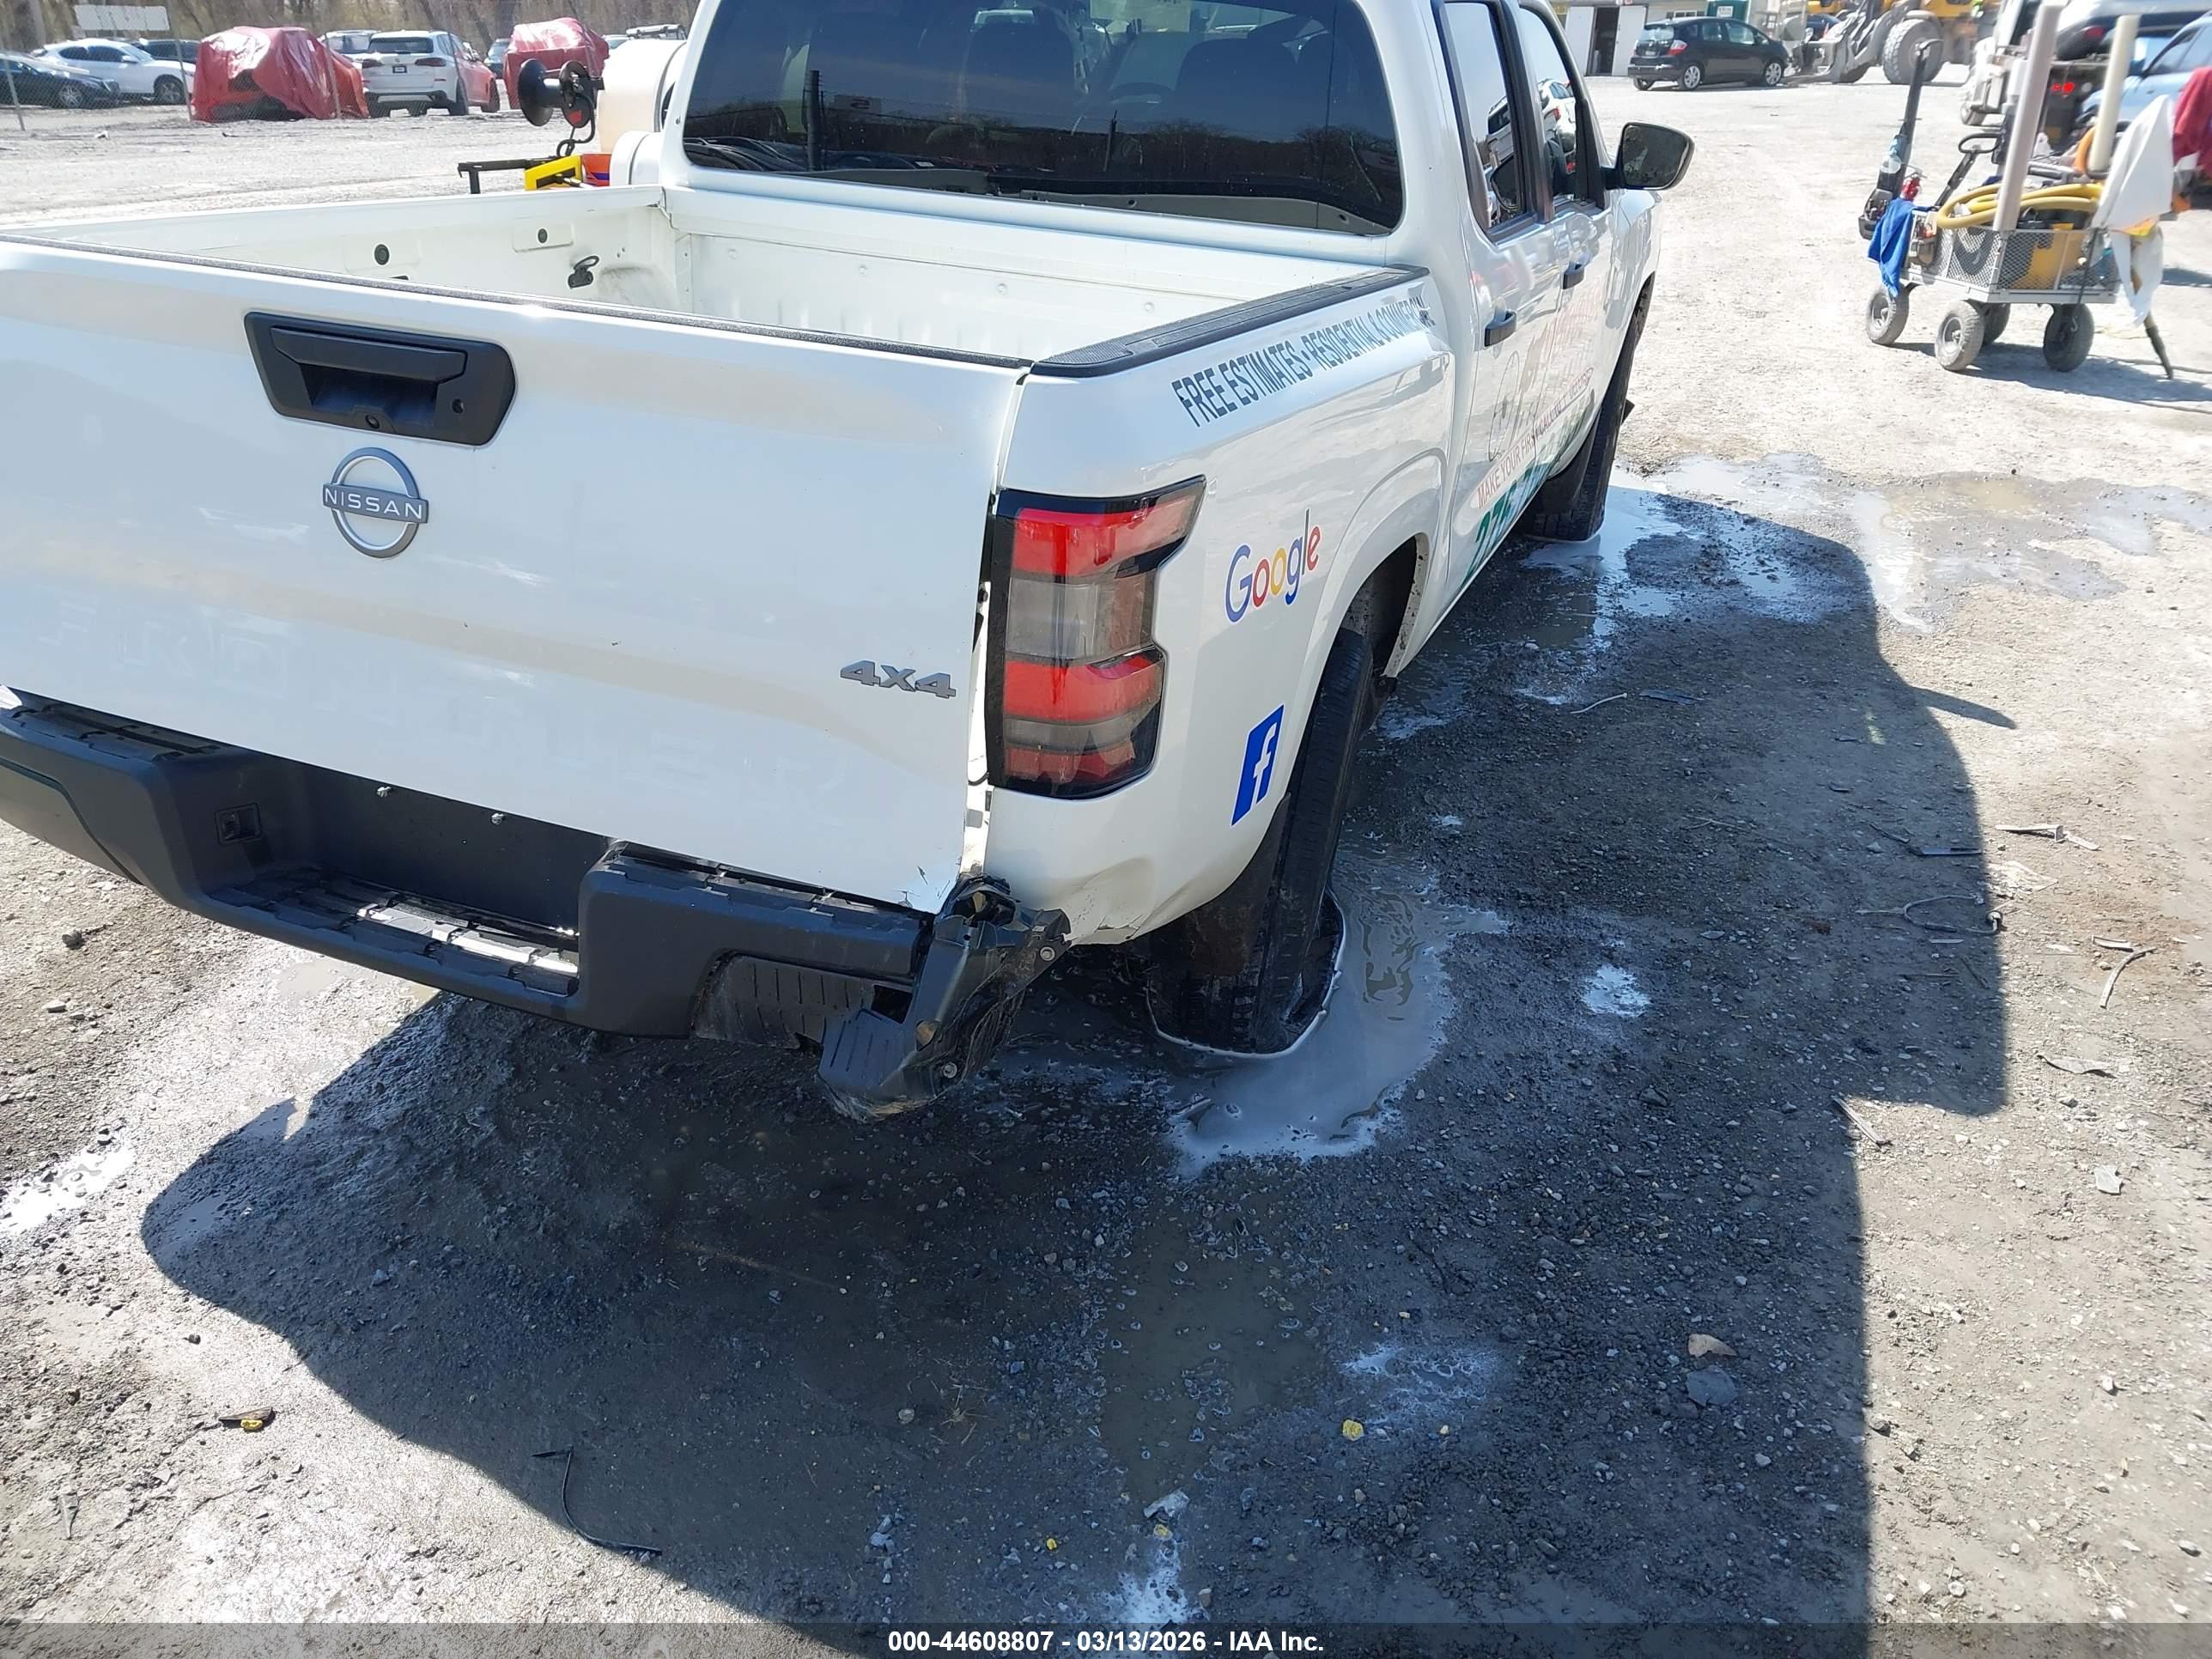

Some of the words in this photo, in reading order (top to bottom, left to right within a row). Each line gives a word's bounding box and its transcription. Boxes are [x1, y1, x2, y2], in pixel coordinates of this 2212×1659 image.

[1171, 367, 1237, 427] FREE
[1218, 340, 1314, 406] ESTIMATES
[1300, 315, 1385, 371] RESIDENTIAL
[325, 487, 422, 520] NISSAN
[1477, 467, 1501, 508] MAKE
[1502, 449, 1522, 483] YOUR
[1224, 508, 1321, 623] Google
